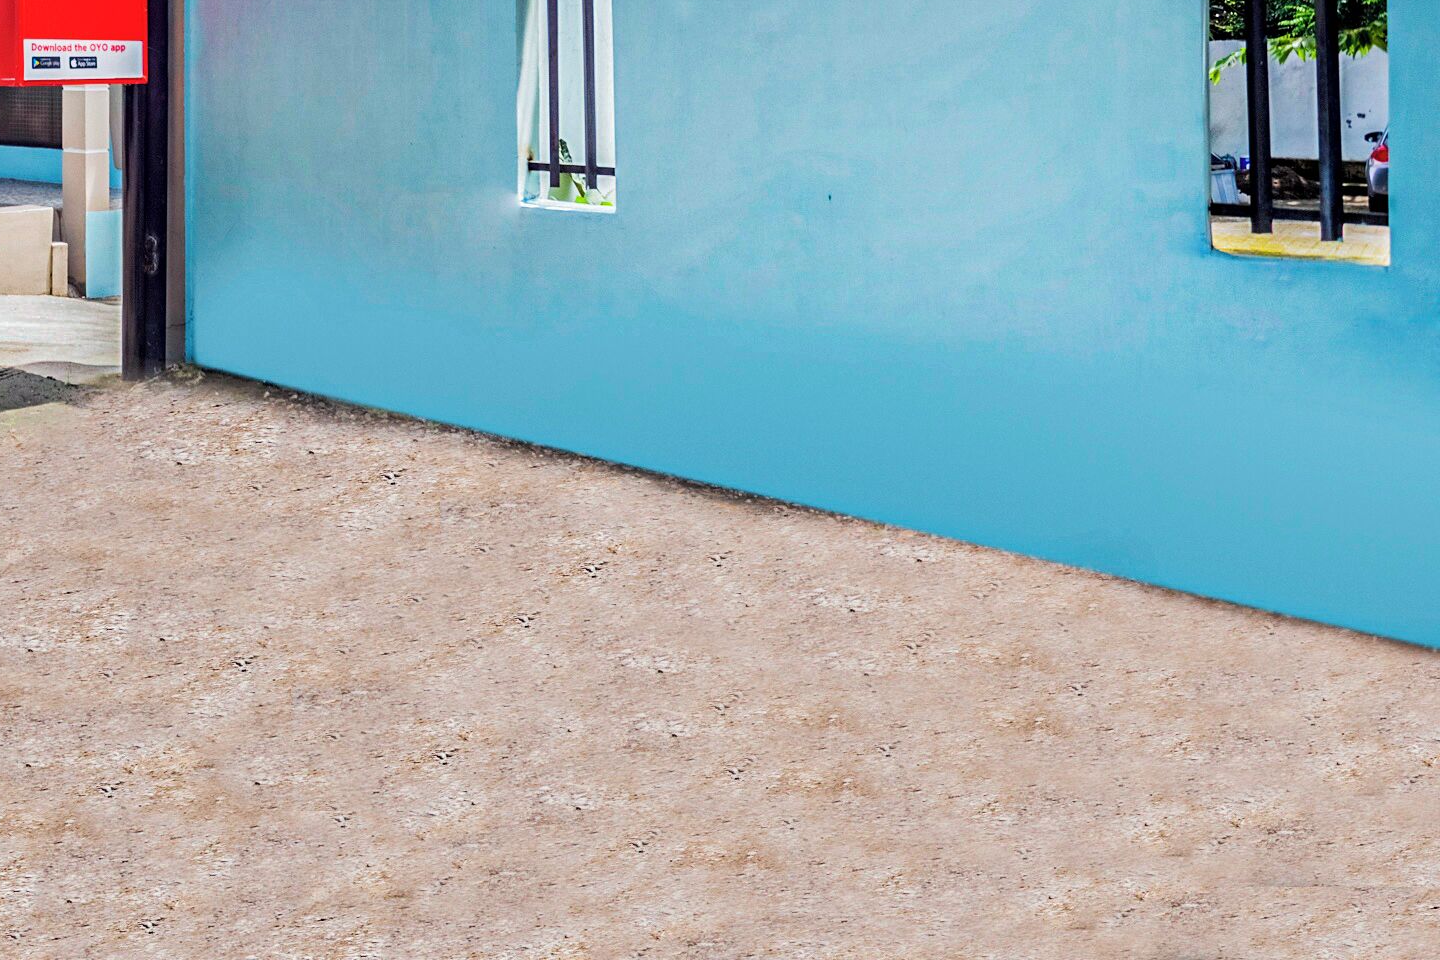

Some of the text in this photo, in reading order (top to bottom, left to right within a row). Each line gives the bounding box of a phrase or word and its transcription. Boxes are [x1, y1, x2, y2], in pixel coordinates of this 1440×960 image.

[31, 43, 126, 53] Download the OYO app
